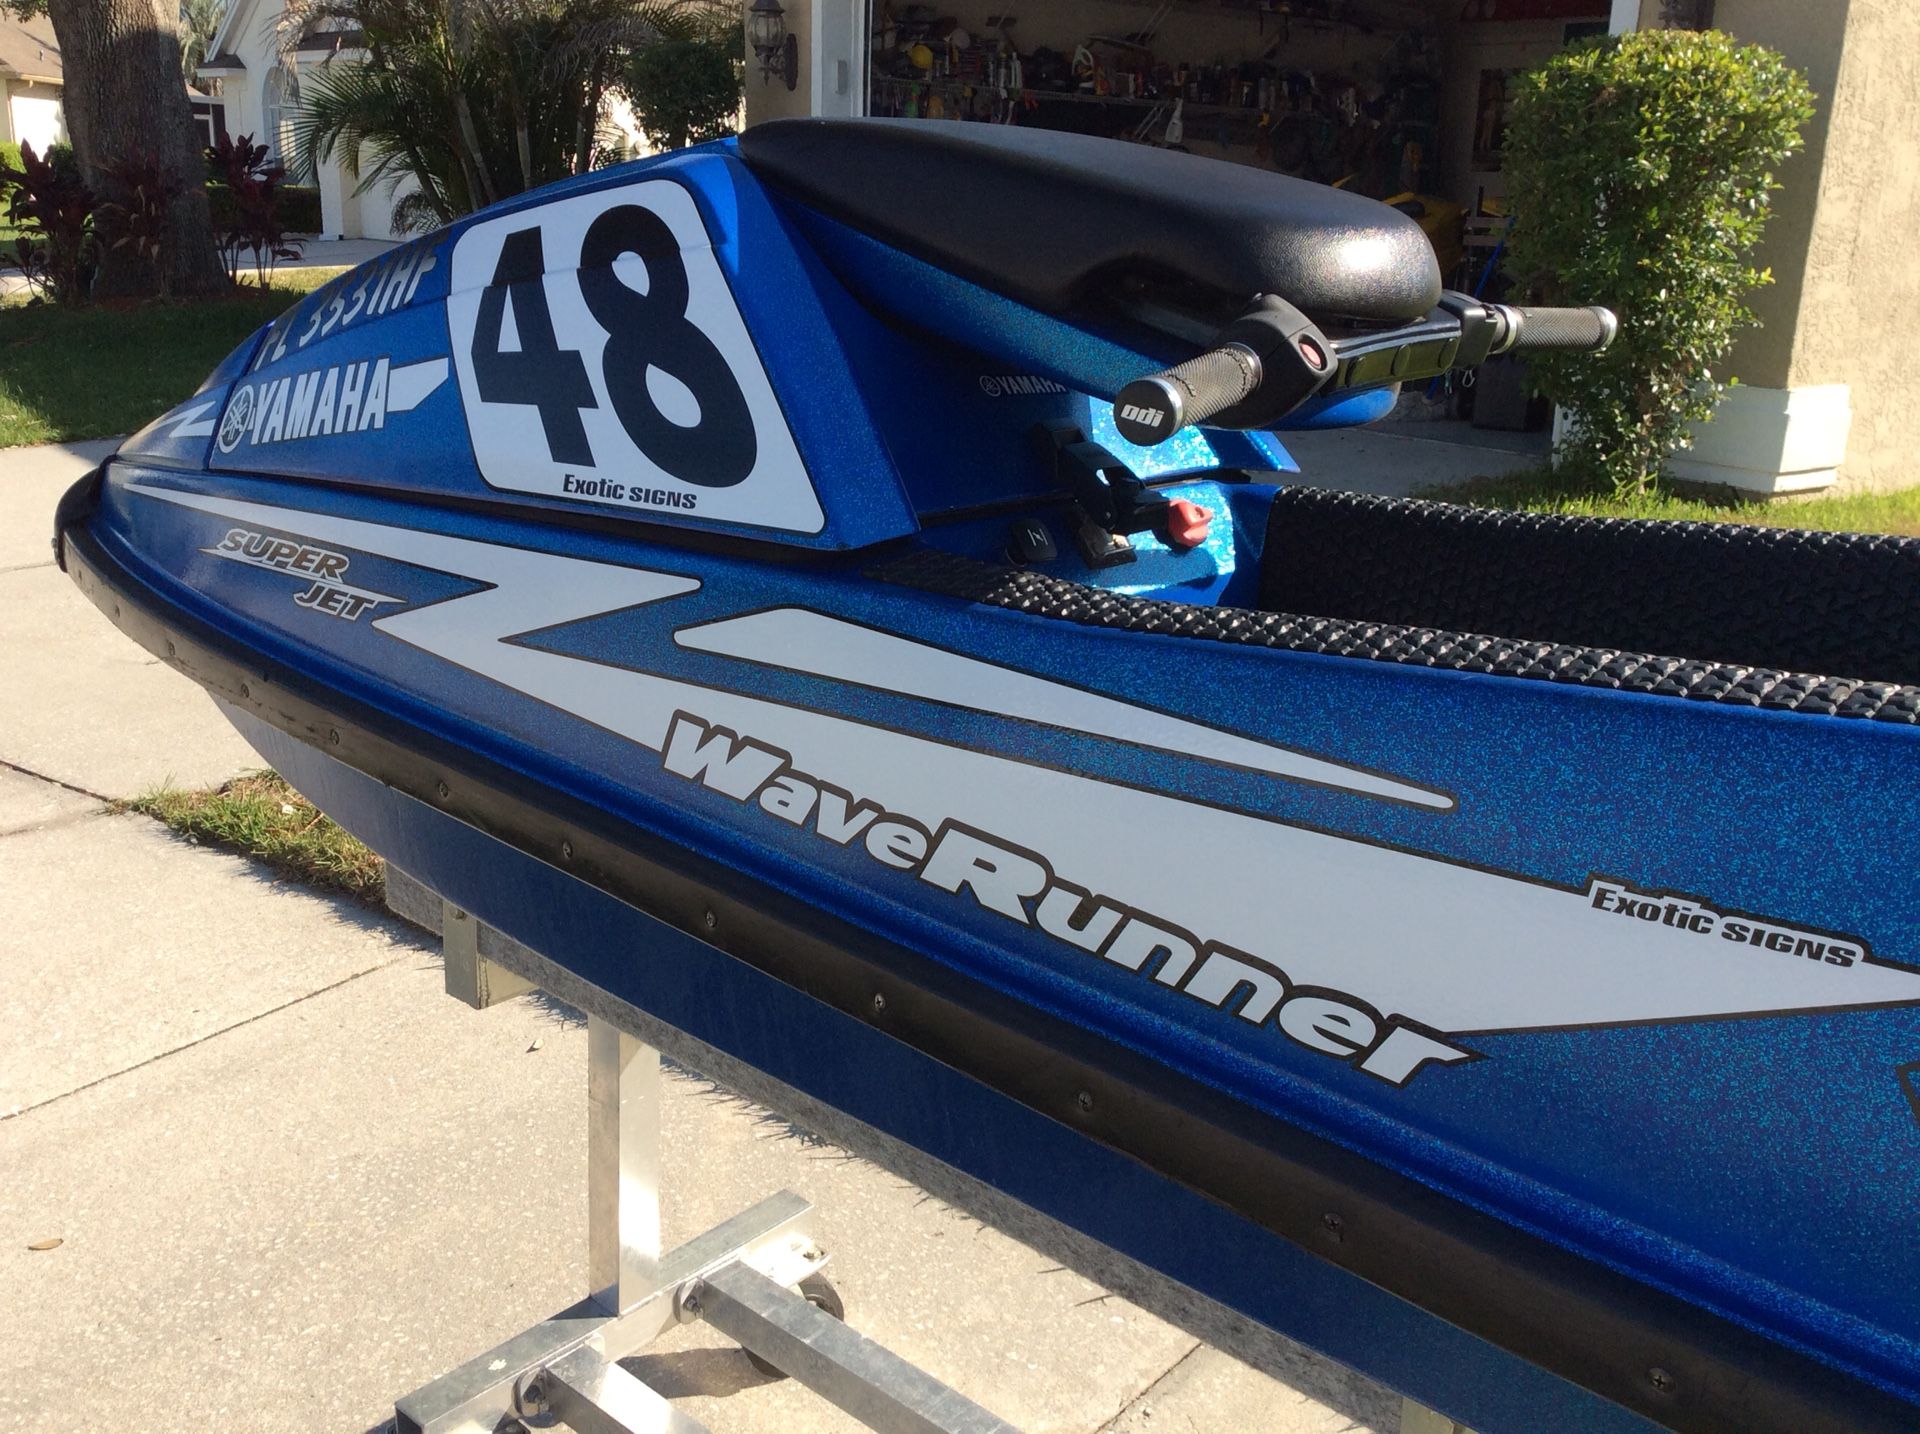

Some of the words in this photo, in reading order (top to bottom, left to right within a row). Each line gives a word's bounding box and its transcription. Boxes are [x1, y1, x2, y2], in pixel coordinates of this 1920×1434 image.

[471, 204, 758, 488] 48
[251, 357, 390, 446] YAMAHA
[1120, 404, 1165, 428] odi
[562, 473, 625, 500] Exotic
[628, 486, 698, 510] SIGNS
[217, 528, 349, 583] SUPER
[294, 581, 376, 621] JET
[659, 712, 1478, 1088] WaveRunner
[1590, 886, 1715, 935] Exotic
[1720, 920, 1858, 969] SIGNS
